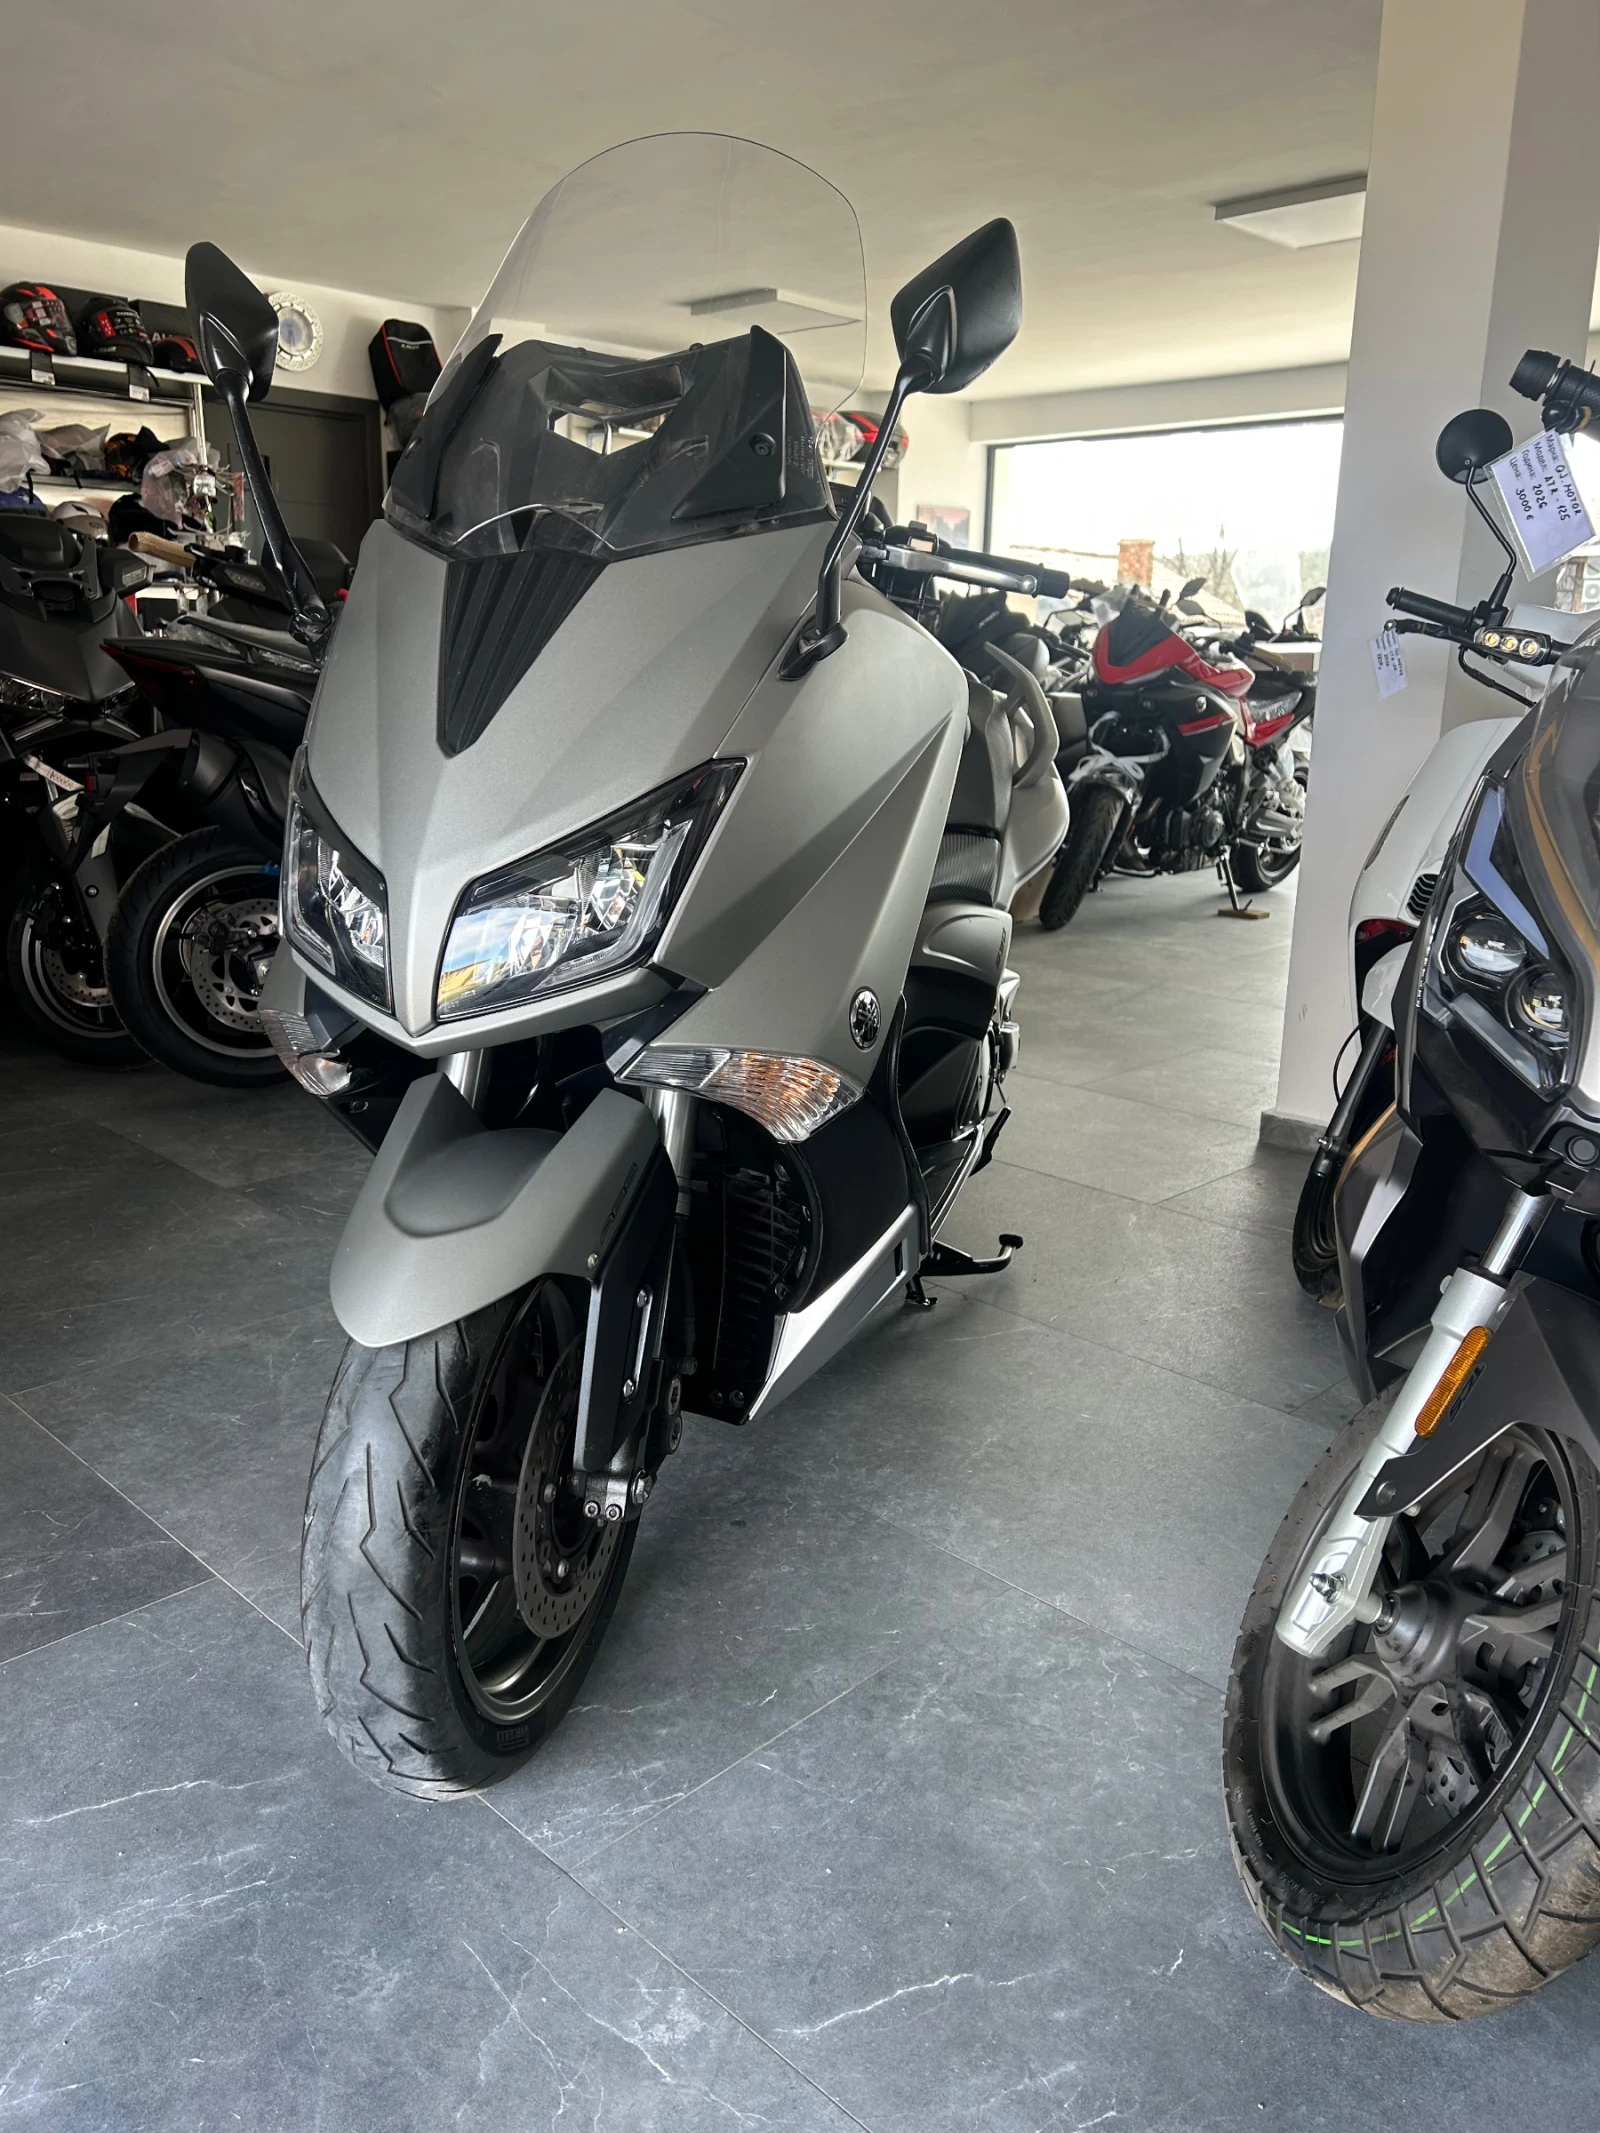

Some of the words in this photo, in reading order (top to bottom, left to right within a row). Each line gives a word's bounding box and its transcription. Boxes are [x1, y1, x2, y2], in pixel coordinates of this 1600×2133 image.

[1546, 434, 1559, 463] Марка:
[1509, 456, 1523, 481] Цена:
[1521, 449, 1536, 480] Година:
[1532, 484, 1548, 509] 2026
[1533, 441, 1548, 472] Модел:
[1544, 476, 1558, 495] ATR
[1557, 505, 1570, 521] 125
[1515, 488, 1532, 512] 3000
[600, 1162, 638, 1245] ABS
[496, 1725, 531, 1752] PIRELLI
